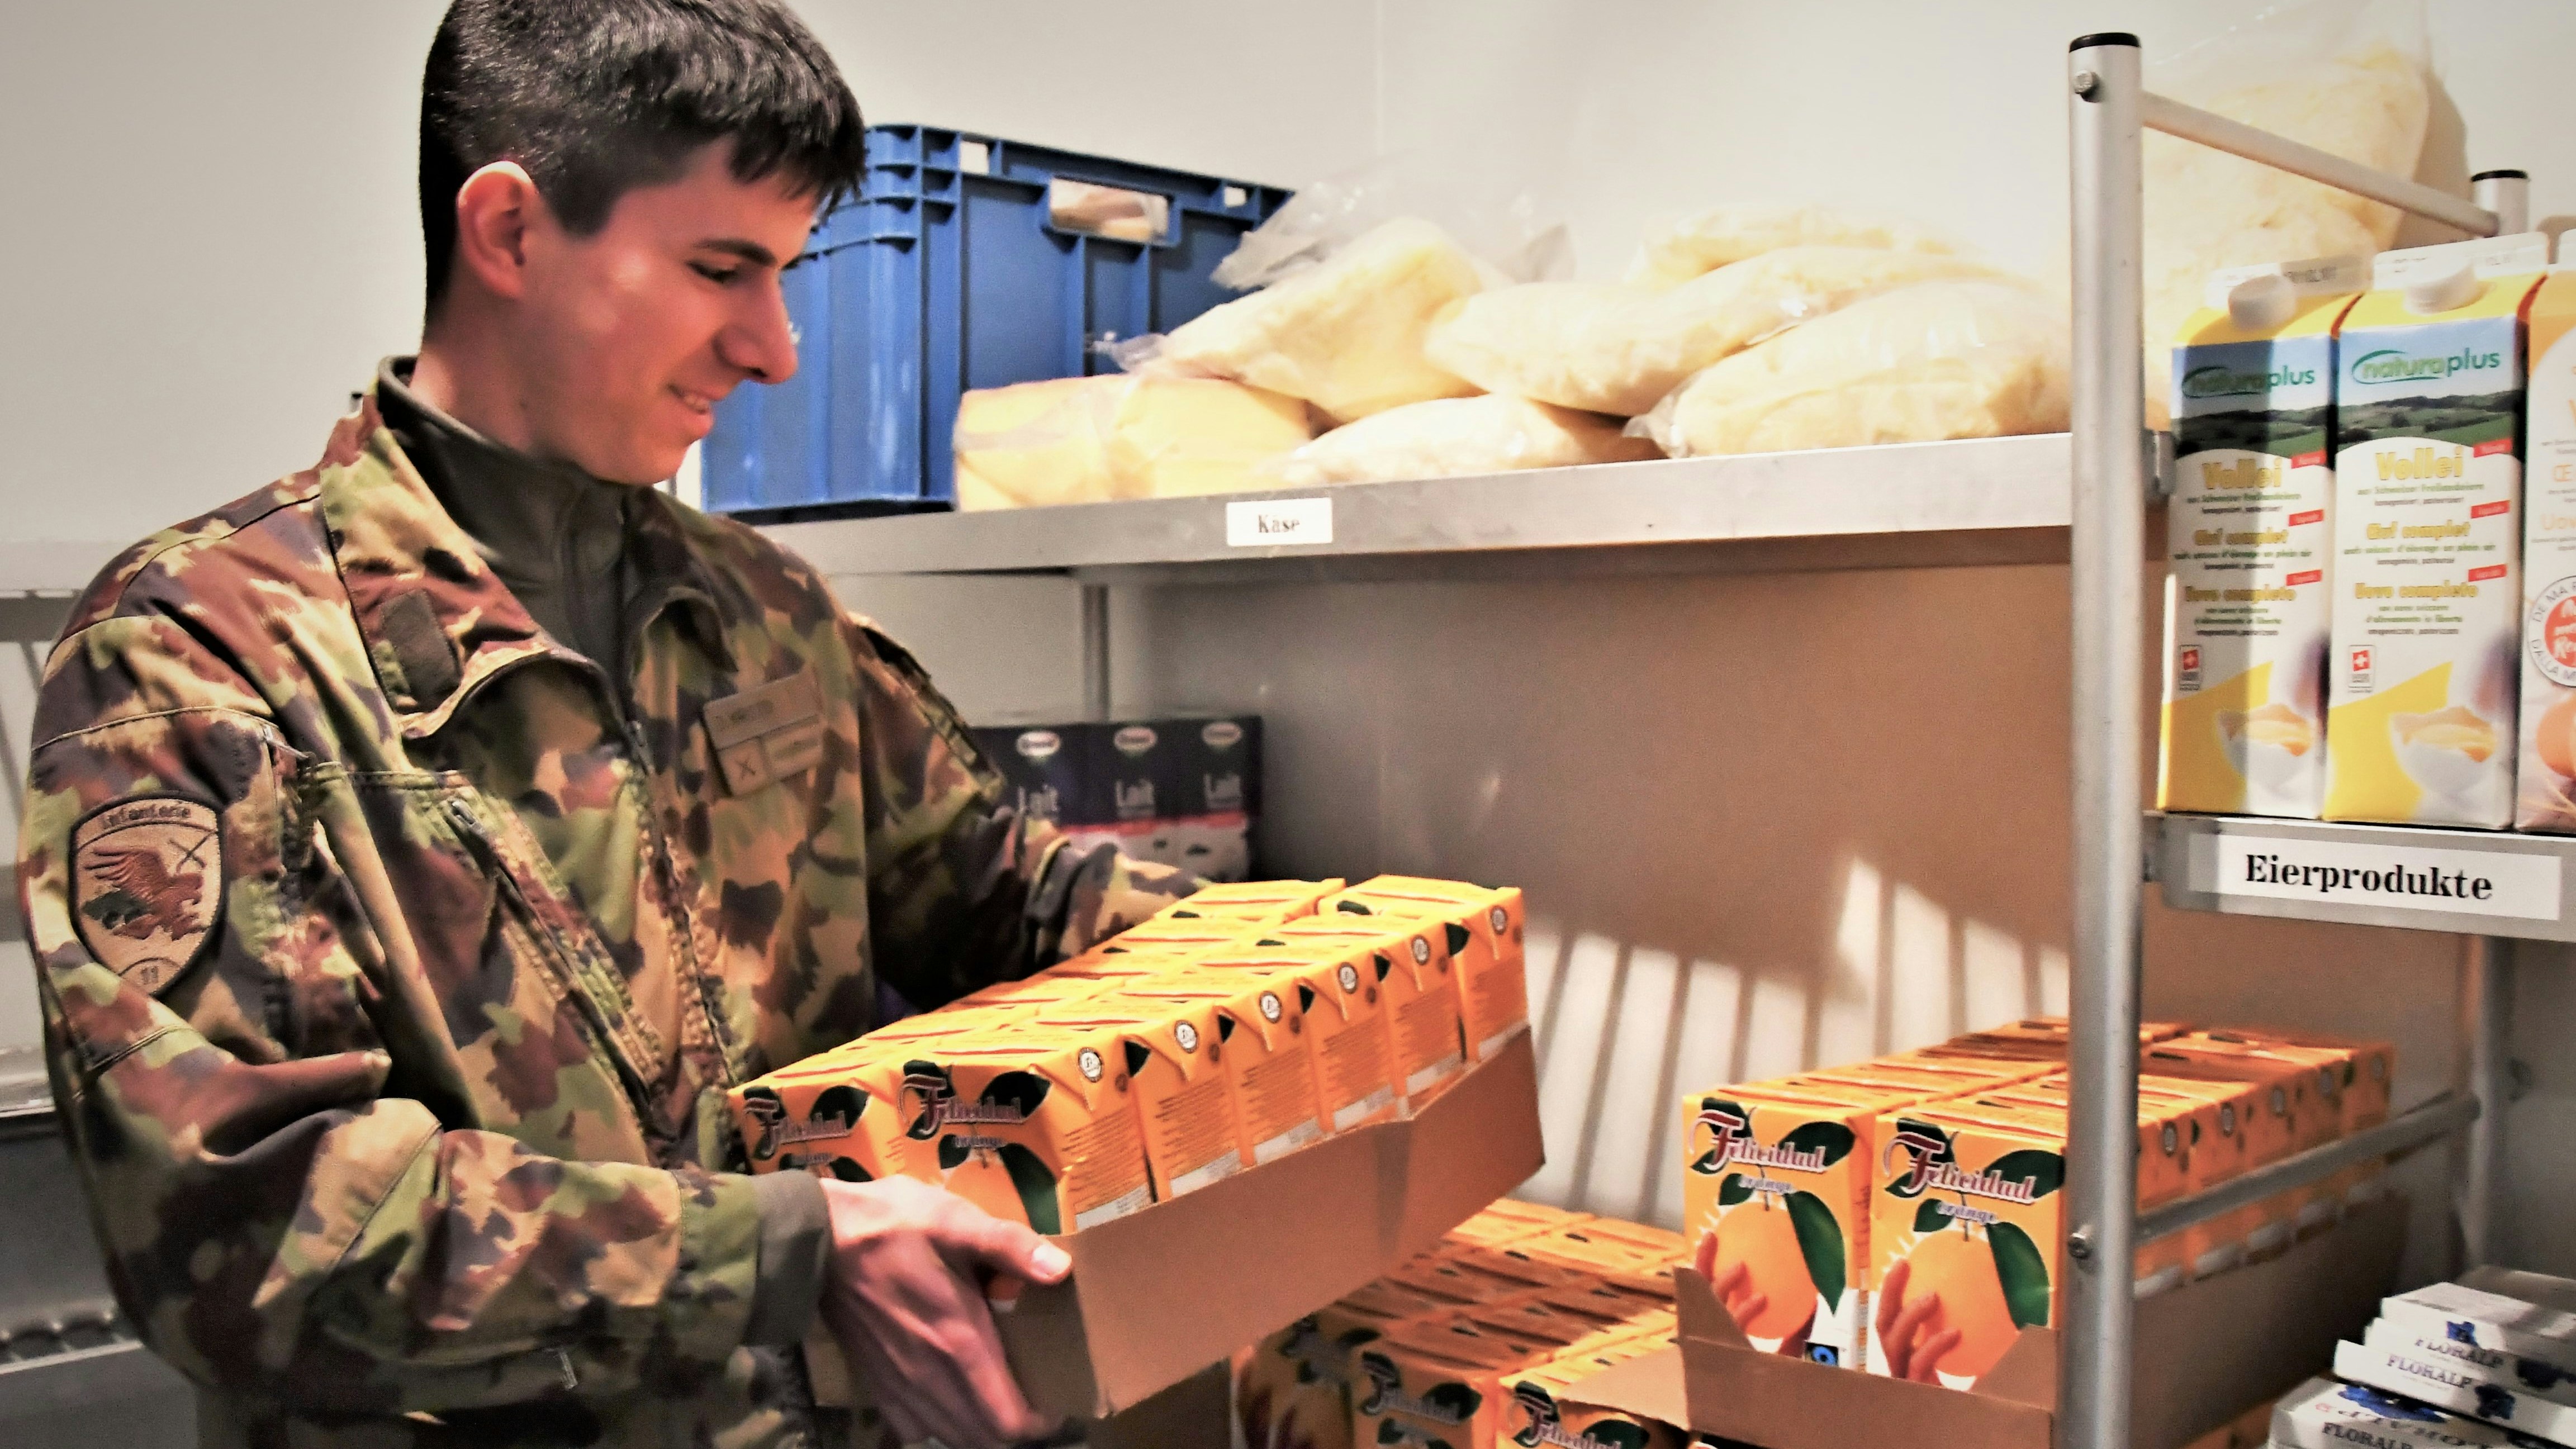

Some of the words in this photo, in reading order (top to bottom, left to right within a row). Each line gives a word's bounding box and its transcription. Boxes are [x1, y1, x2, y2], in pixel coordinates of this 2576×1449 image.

[2202, 457, 2283, 490] Vollei
[2375, 446, 2464, 480] Vollei
[2246, 854, 2493, 900] Eierprodukte
[1883, 1130, 2036, 1205] Felicidad
[2387, 1354, 2473, 1389] FLORALP
